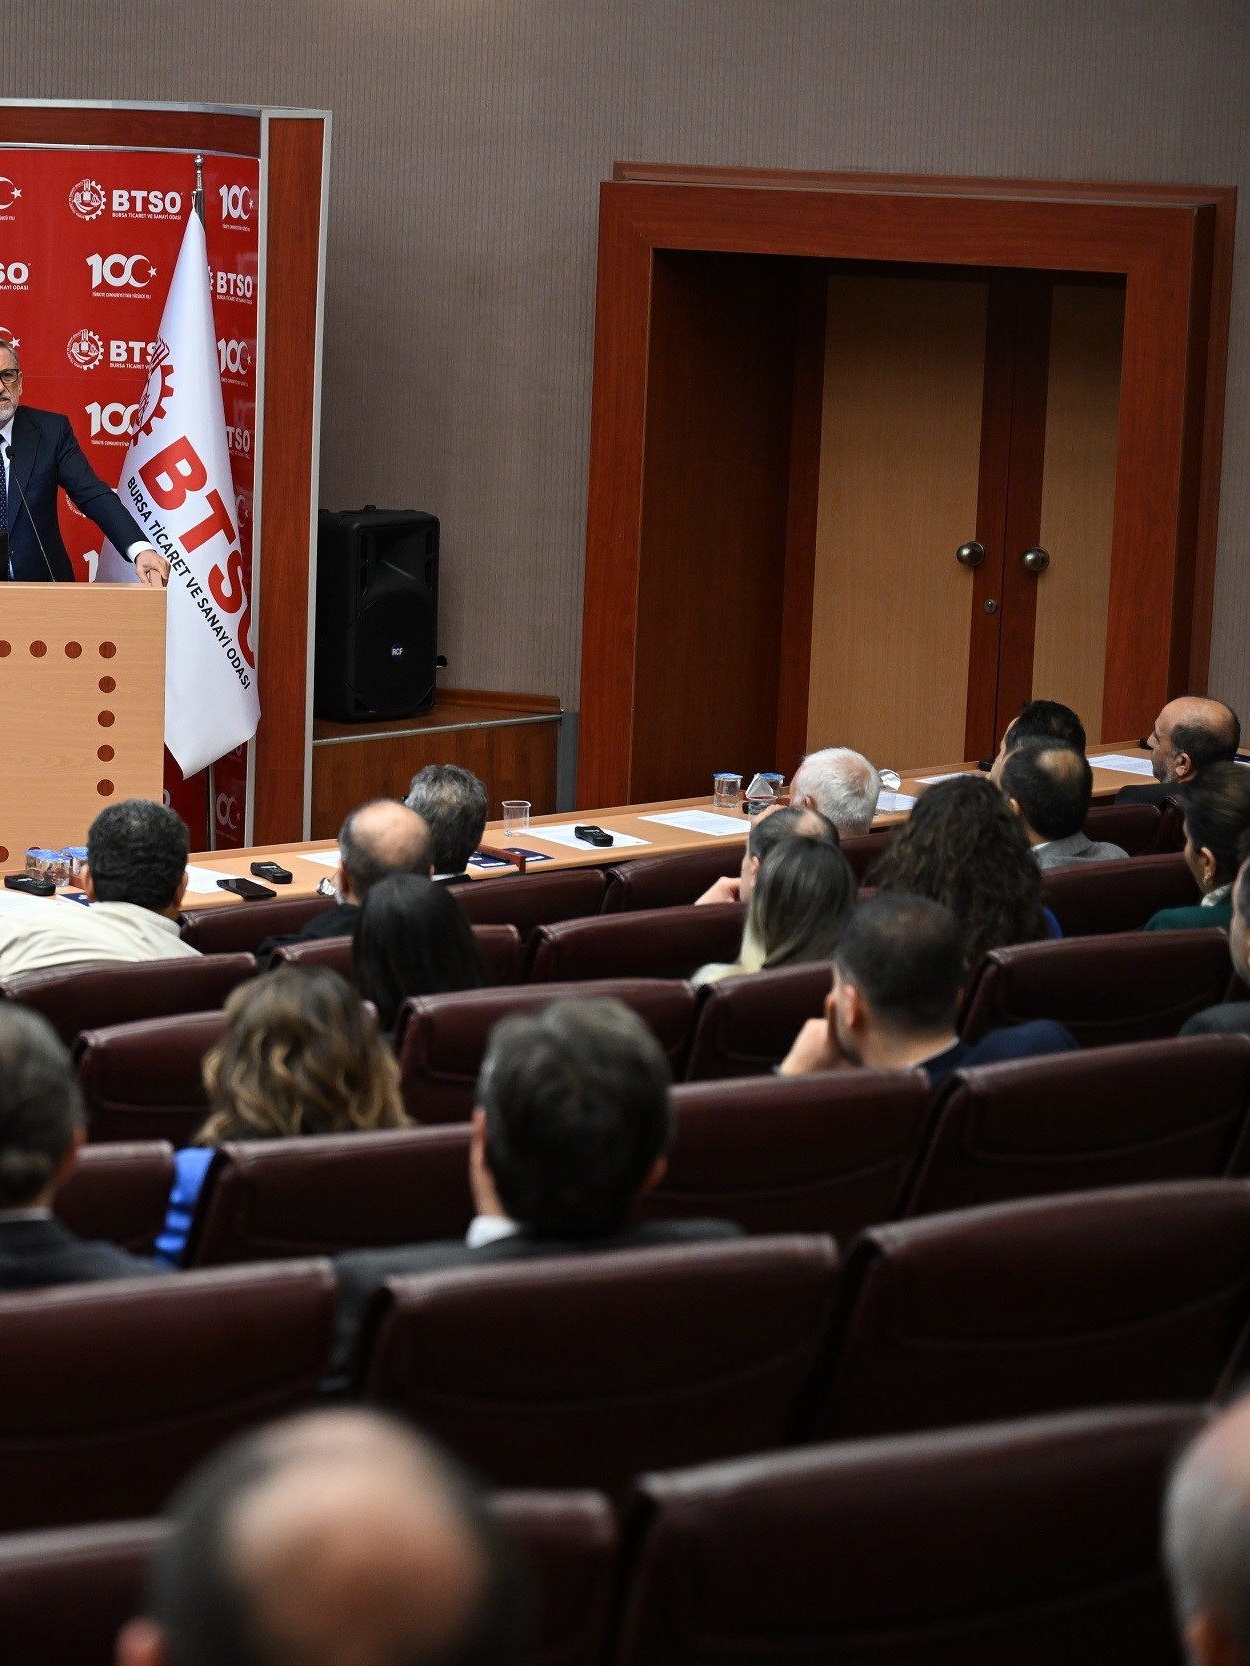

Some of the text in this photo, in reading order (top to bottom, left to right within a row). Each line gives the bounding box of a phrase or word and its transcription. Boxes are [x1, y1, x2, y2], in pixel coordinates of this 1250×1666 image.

[127, 476, 251, 690] BURSA TİCARET VE SANAYİ ODASI
